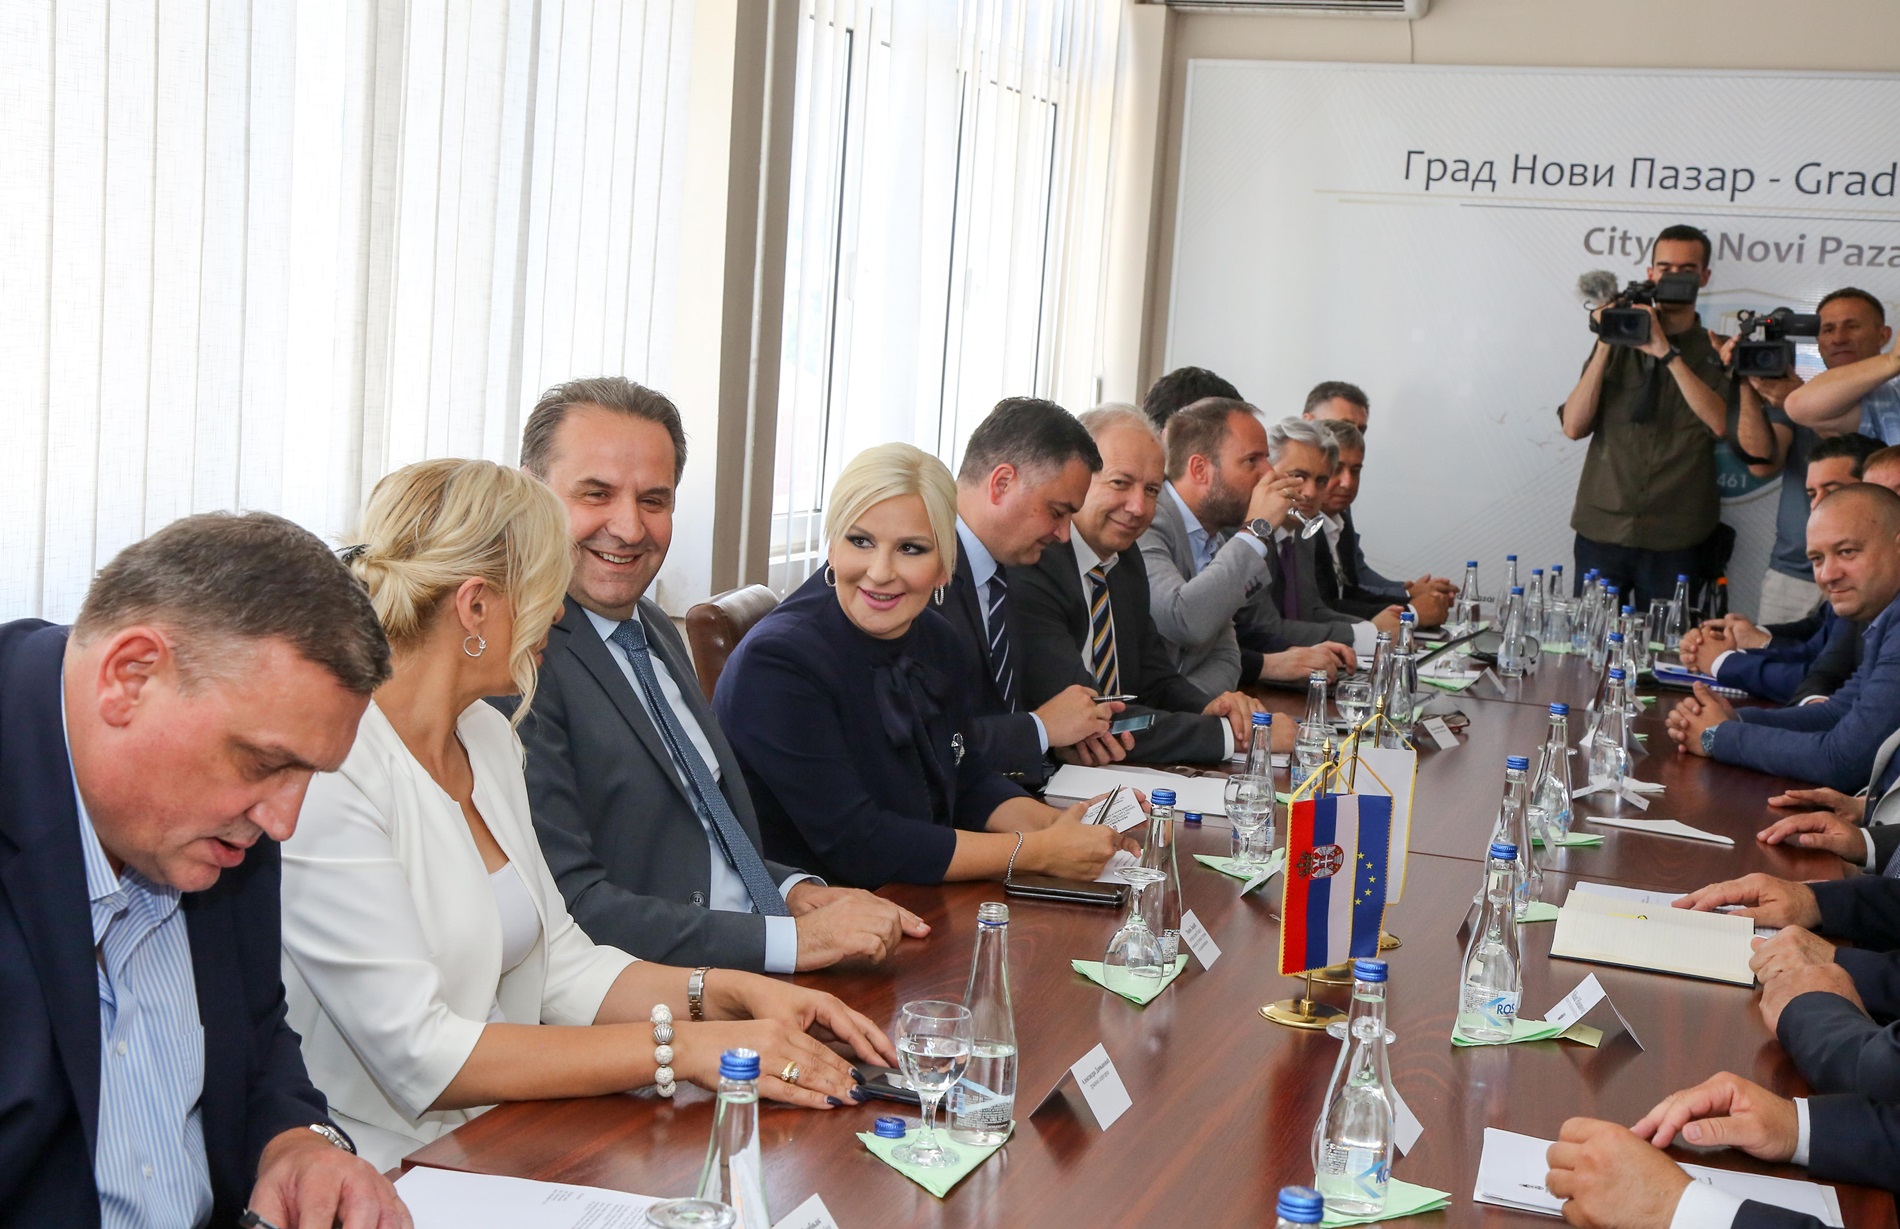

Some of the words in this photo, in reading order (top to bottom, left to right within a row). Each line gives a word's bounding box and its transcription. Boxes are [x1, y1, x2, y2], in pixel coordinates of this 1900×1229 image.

[1404, 150, 1497, 192] Град
[1512, 153, 1615, 188] Нови
[1630, 157, 1756, 202] Пазар
[1795, 162, 1898, 197] Grad
[1583, 226, 1654, 266] City
[1717, 232, 1807, 264] Novi
[1818, 236, 1900, 268] Paza
